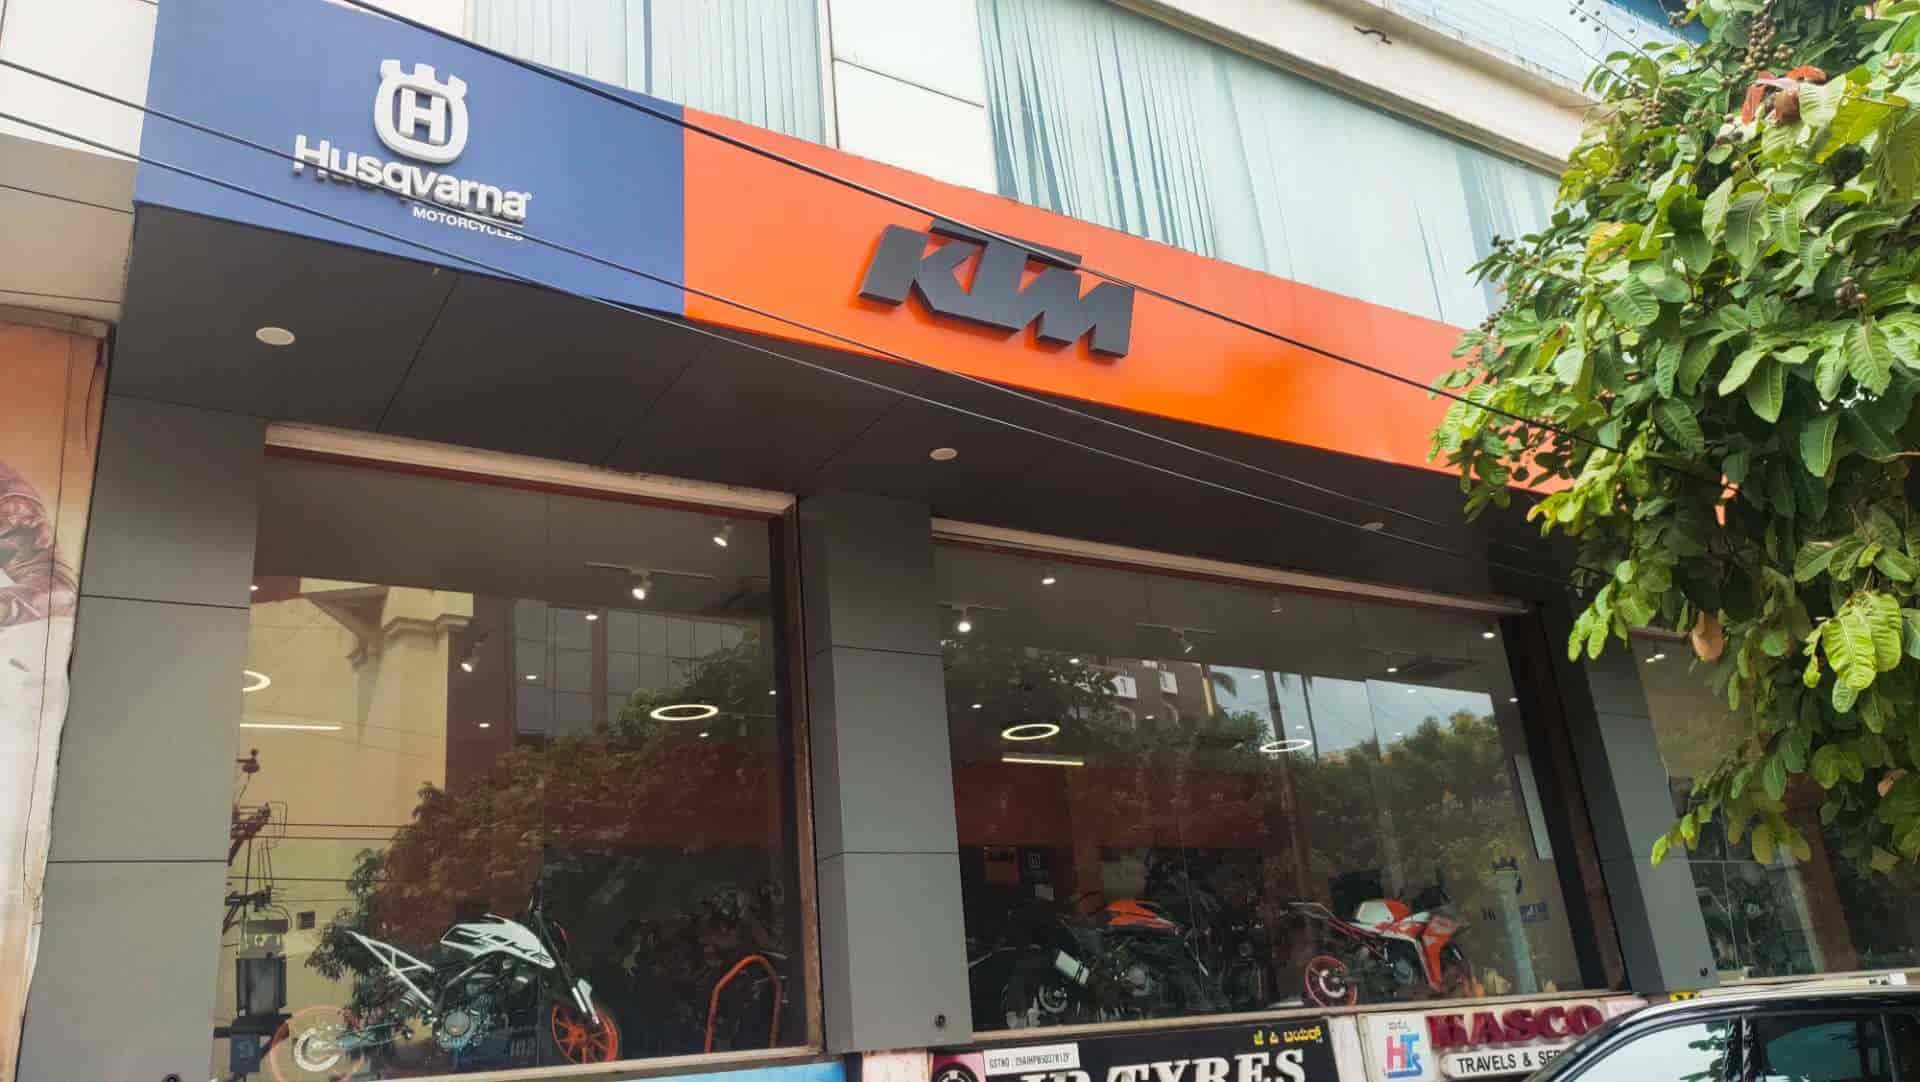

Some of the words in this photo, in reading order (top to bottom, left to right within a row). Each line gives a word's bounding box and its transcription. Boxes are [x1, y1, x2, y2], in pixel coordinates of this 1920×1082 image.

[292, 133, 529, 219] Husqvarna
[859, 216, 1135, 359] KTM
[1456, 1054, 1517, 1073] TRAVELS
[1523, 1053, 1531, 1067] &
